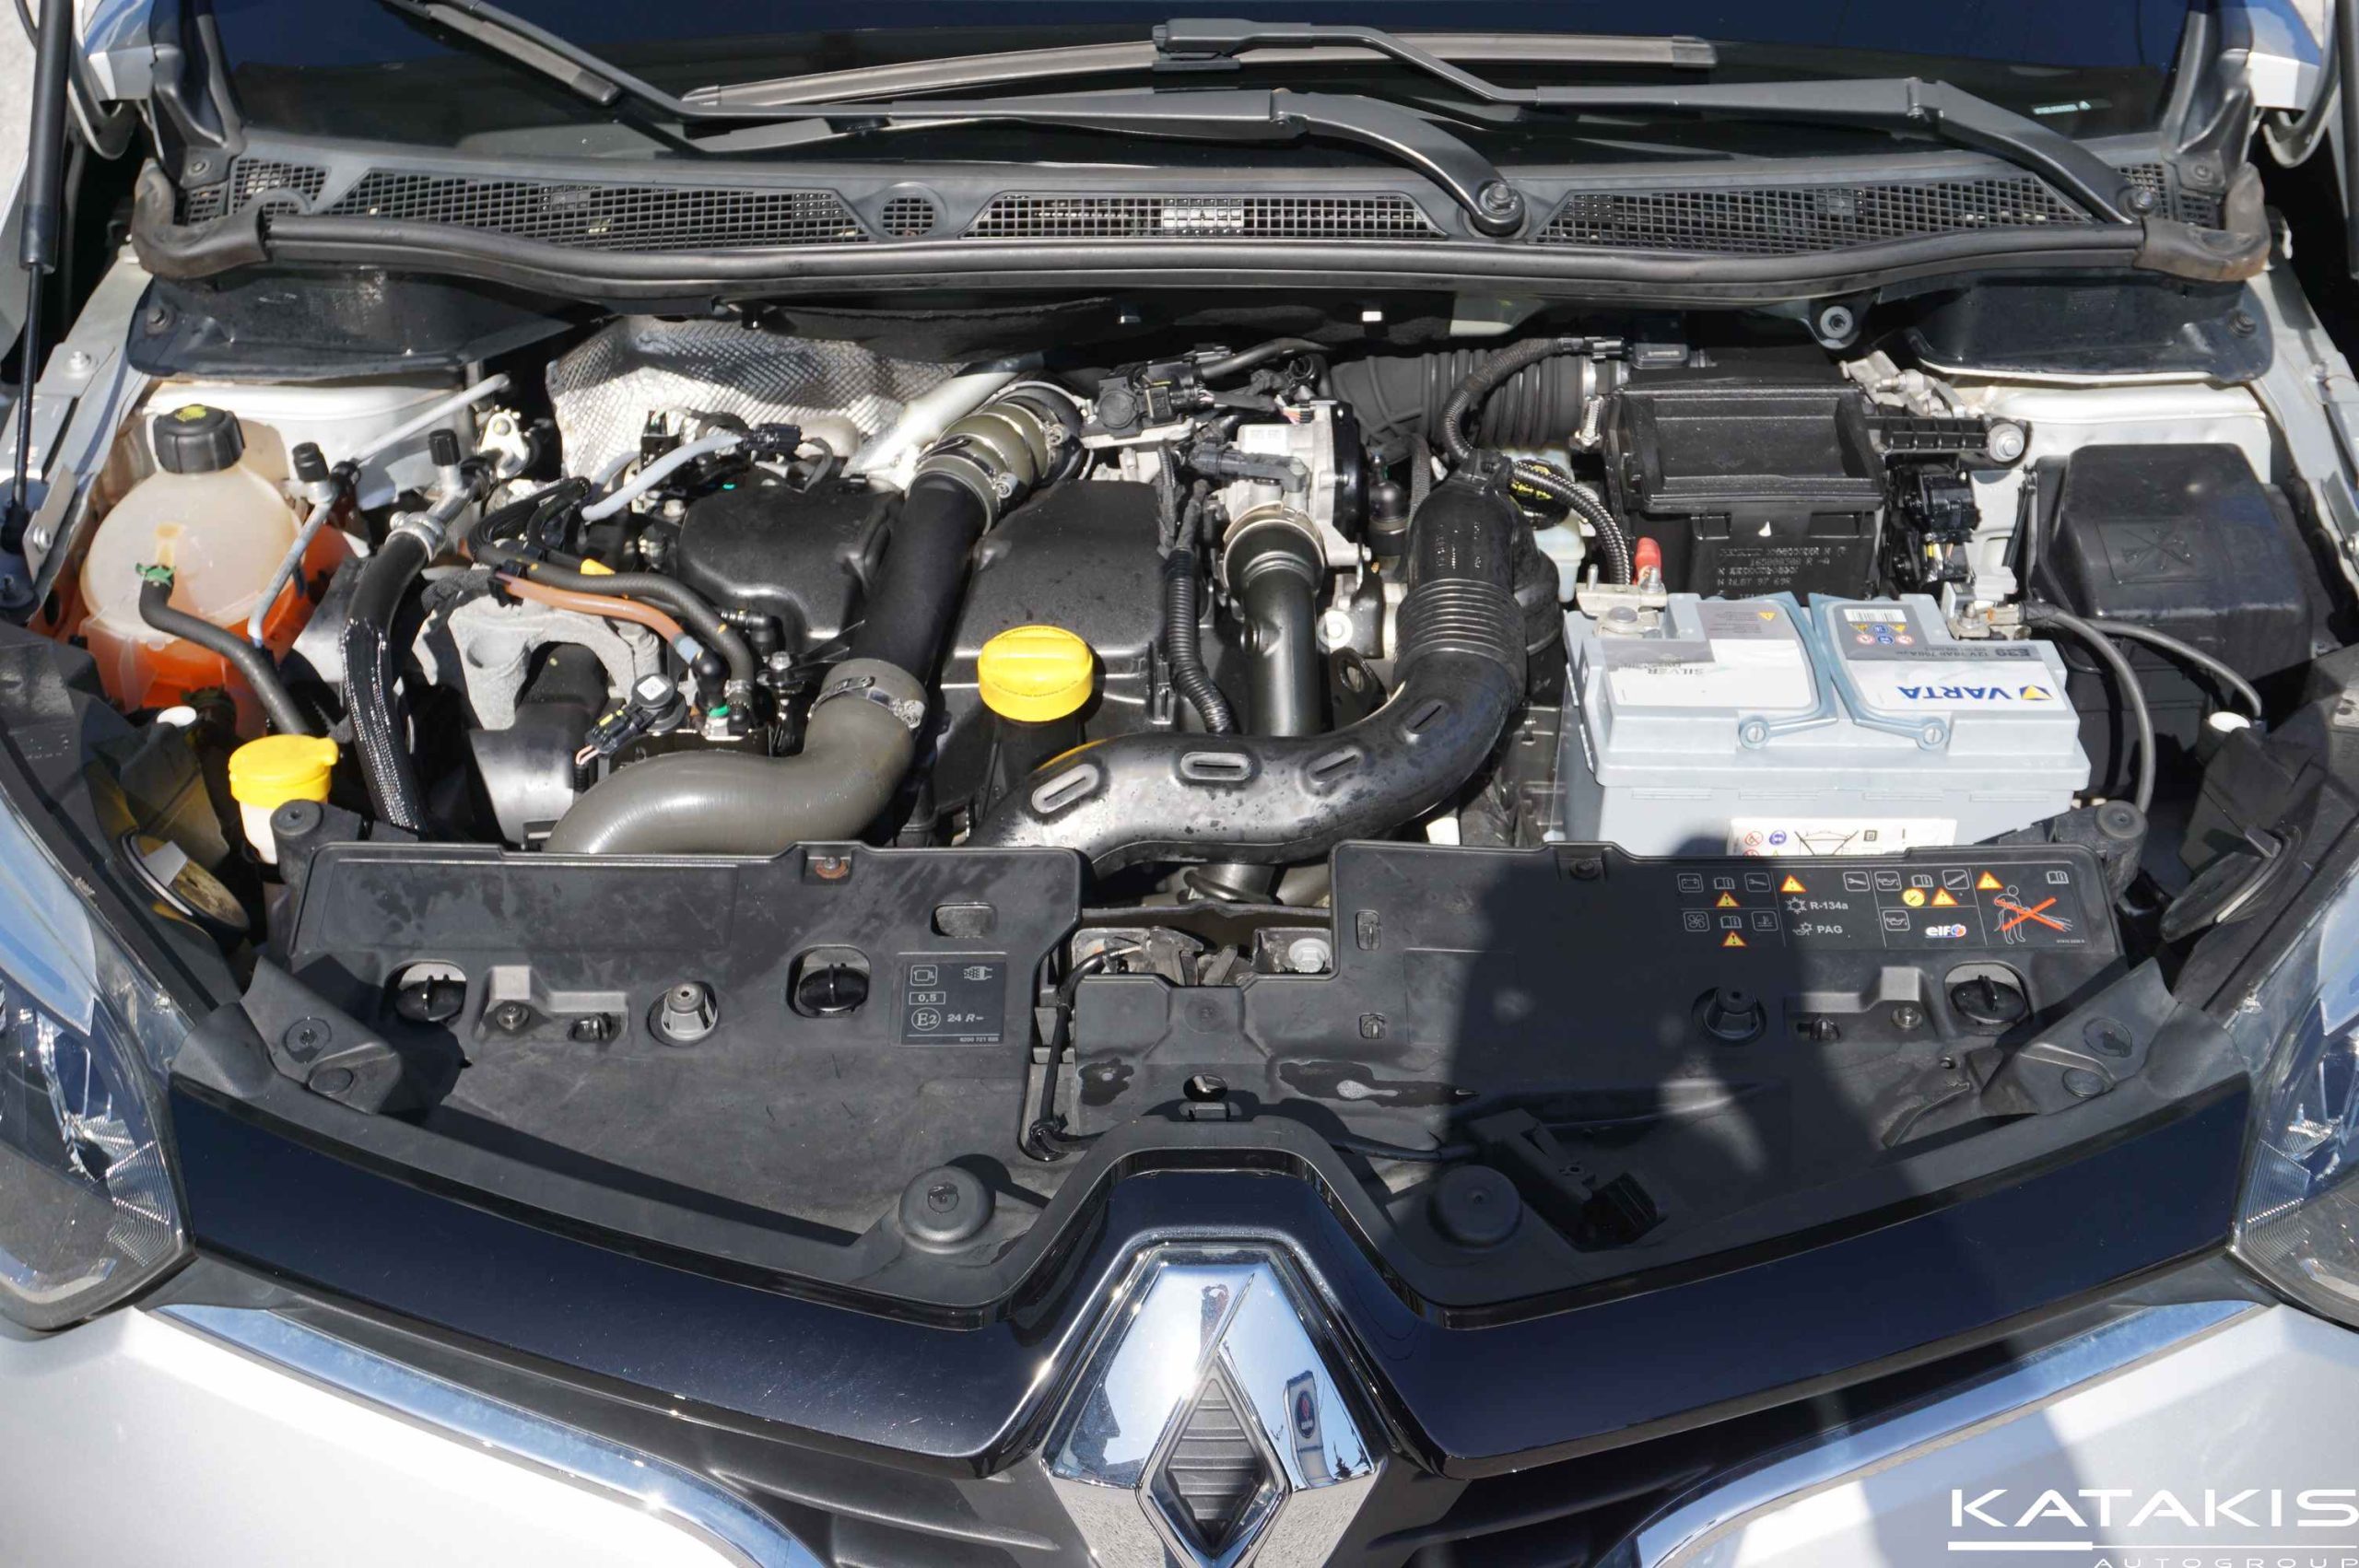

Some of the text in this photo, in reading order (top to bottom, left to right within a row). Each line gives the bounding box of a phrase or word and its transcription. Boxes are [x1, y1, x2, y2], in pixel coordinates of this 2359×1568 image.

[1897, 686, 2013, 700] VARTA
[1810, 901, 1849, 910] R-134a
[1816, 925, 1843, 934] PAG
[916, 1012, 937, 1027] E2
[947, 1014, 962, 1023] 24
